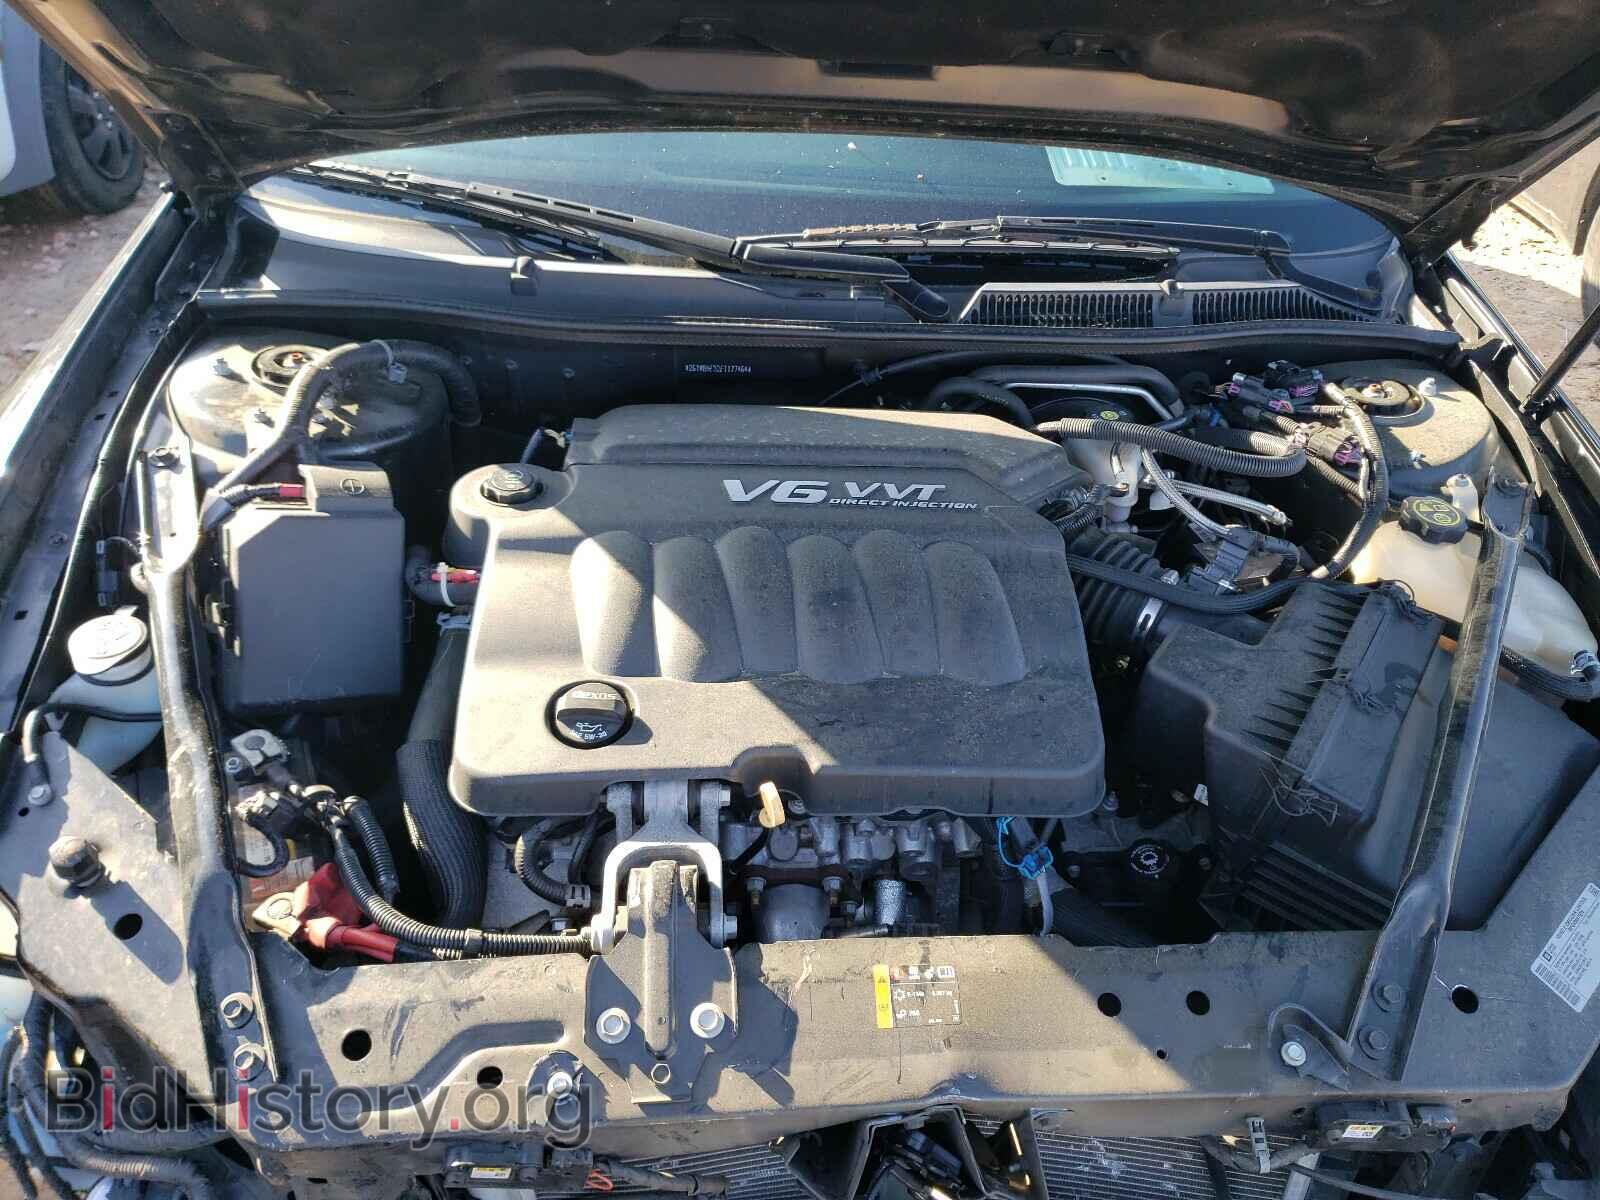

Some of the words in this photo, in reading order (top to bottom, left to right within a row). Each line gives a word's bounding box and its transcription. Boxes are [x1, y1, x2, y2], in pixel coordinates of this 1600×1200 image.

[722, 479, 830, 504] V6
[844, 482, 946, 500] VVT
[829, 498, 890, 507] DIRECT
[892, 500, 979, 510] INJECTION
